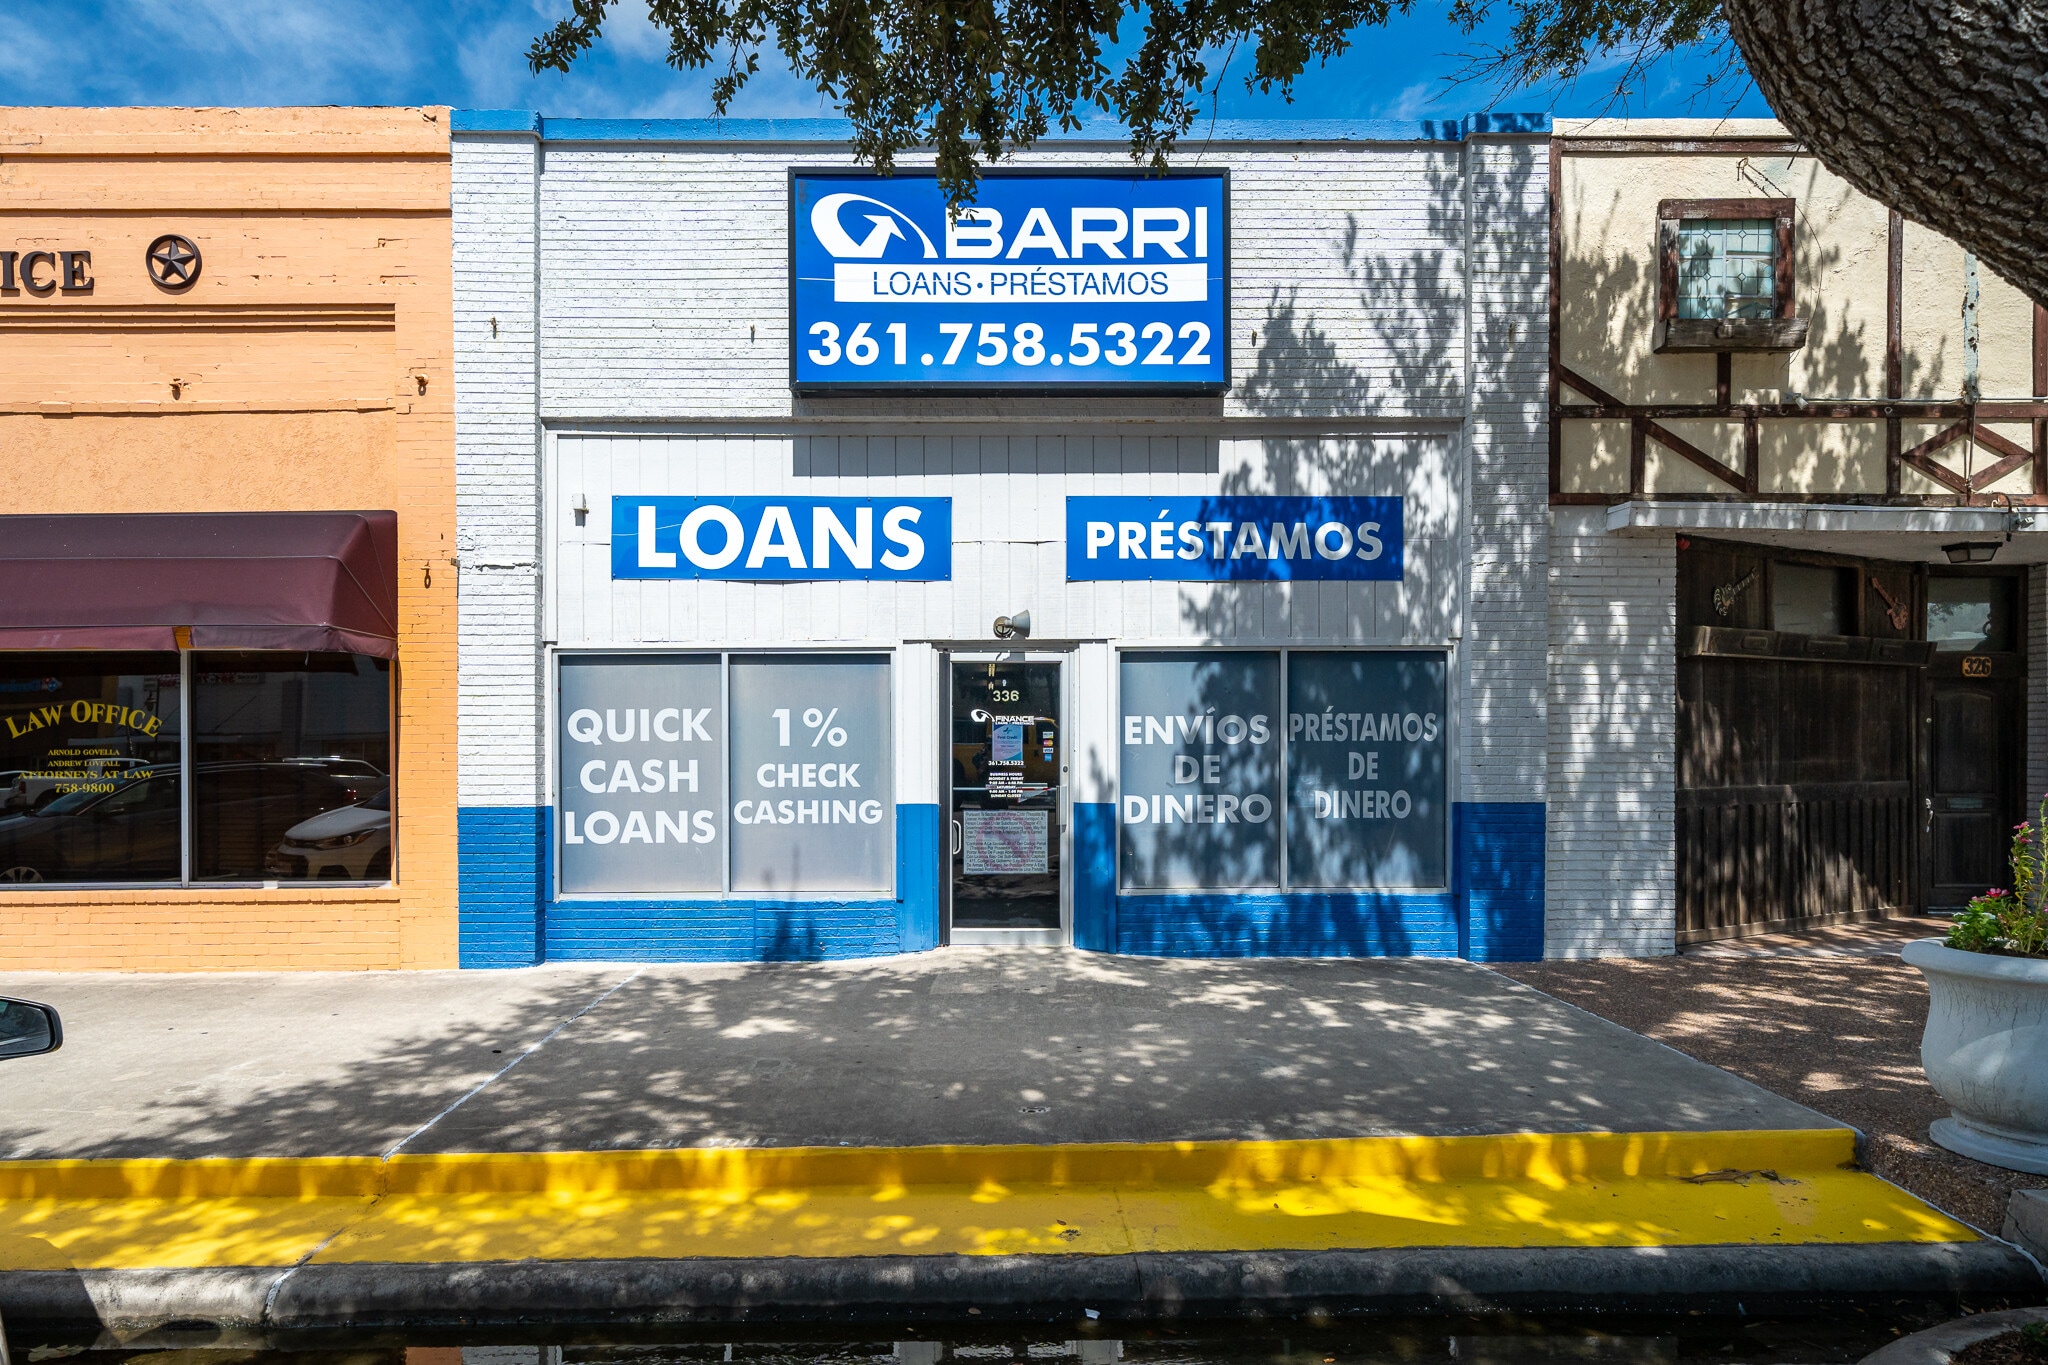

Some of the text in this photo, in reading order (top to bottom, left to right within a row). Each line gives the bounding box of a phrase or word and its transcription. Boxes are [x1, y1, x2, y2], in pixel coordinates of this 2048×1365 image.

[945, 206, 1208, 260] BARRI
[0, 250, 95, 292] ICE
[873, 266, 1169, 296] LOANS PRÉSTAMOS
[808, 320, 1211, 367] 361.758.5322
[638, 504, 926, 571] LOANS
[1087, 512, 1384, 562] PRÉSTAMOS
[1965, 657, 1991, 675] 326
[992, 690, 1020, 702] 336
[5, 700, 163, 739] LAW OFFICE
[567, 708, 713, 746] QUICK
[772, 707, 848, 748] 1%
[1124, 706, 1271, 745] ENVÍOS
[1289, 705, 1438, 742] PRÉSTAMOS
[18, 770, 153, 779] ATTORNEYS AT LAW
[580, 759, 699, 794] CASH
[756, 763, 861, 788] CHECK
[1174, 755, 1221, 784] DE
[1348, 751, 1378, 780] DE
[55, 783, 115, 793] 758-9800
[1314, 790, 1412, 819] DINERO
[733, 799, 883, 825] CASHING
[1123, 793, 1272, 824] DINERO
[565, 810, 716, 845] LOANS
